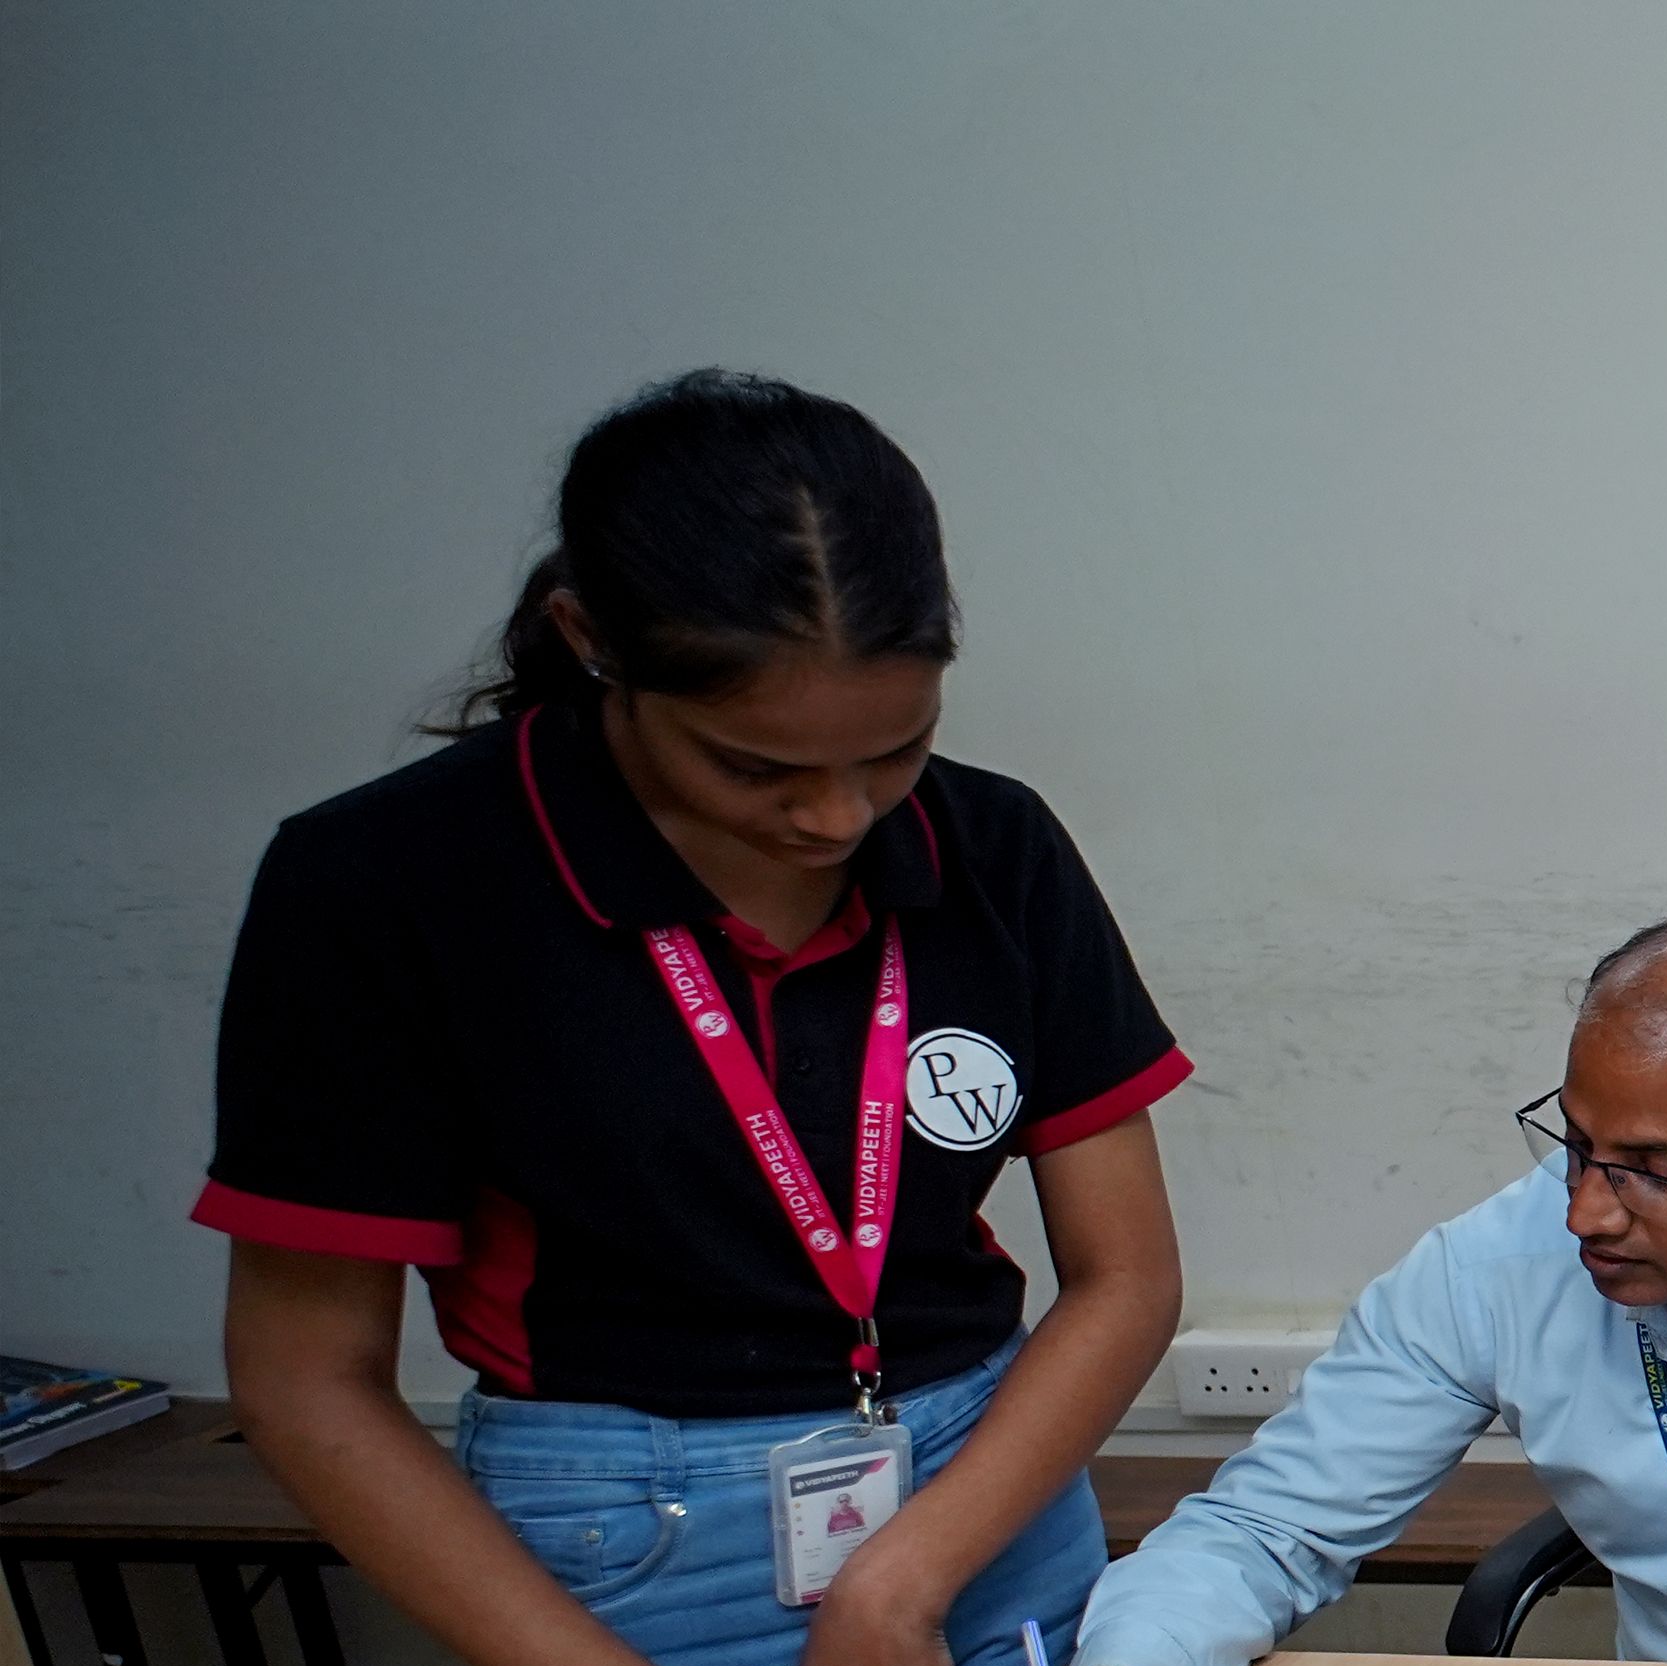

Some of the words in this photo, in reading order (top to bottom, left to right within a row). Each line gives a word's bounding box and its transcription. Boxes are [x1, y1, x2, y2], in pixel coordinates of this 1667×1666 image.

[766, 1110, 798, 1163] FOUNDATION
[883, 1103, 895, 1158] FOUNDATION
[919, 1051, 1007, 1136] PW
[746, 1113, 815, 1227] VIDYAPEETH
[858, 1101, 883, 1218] VIDYAPEETH
[1639, 1322, 1664, 1409] VIDYAPEET
